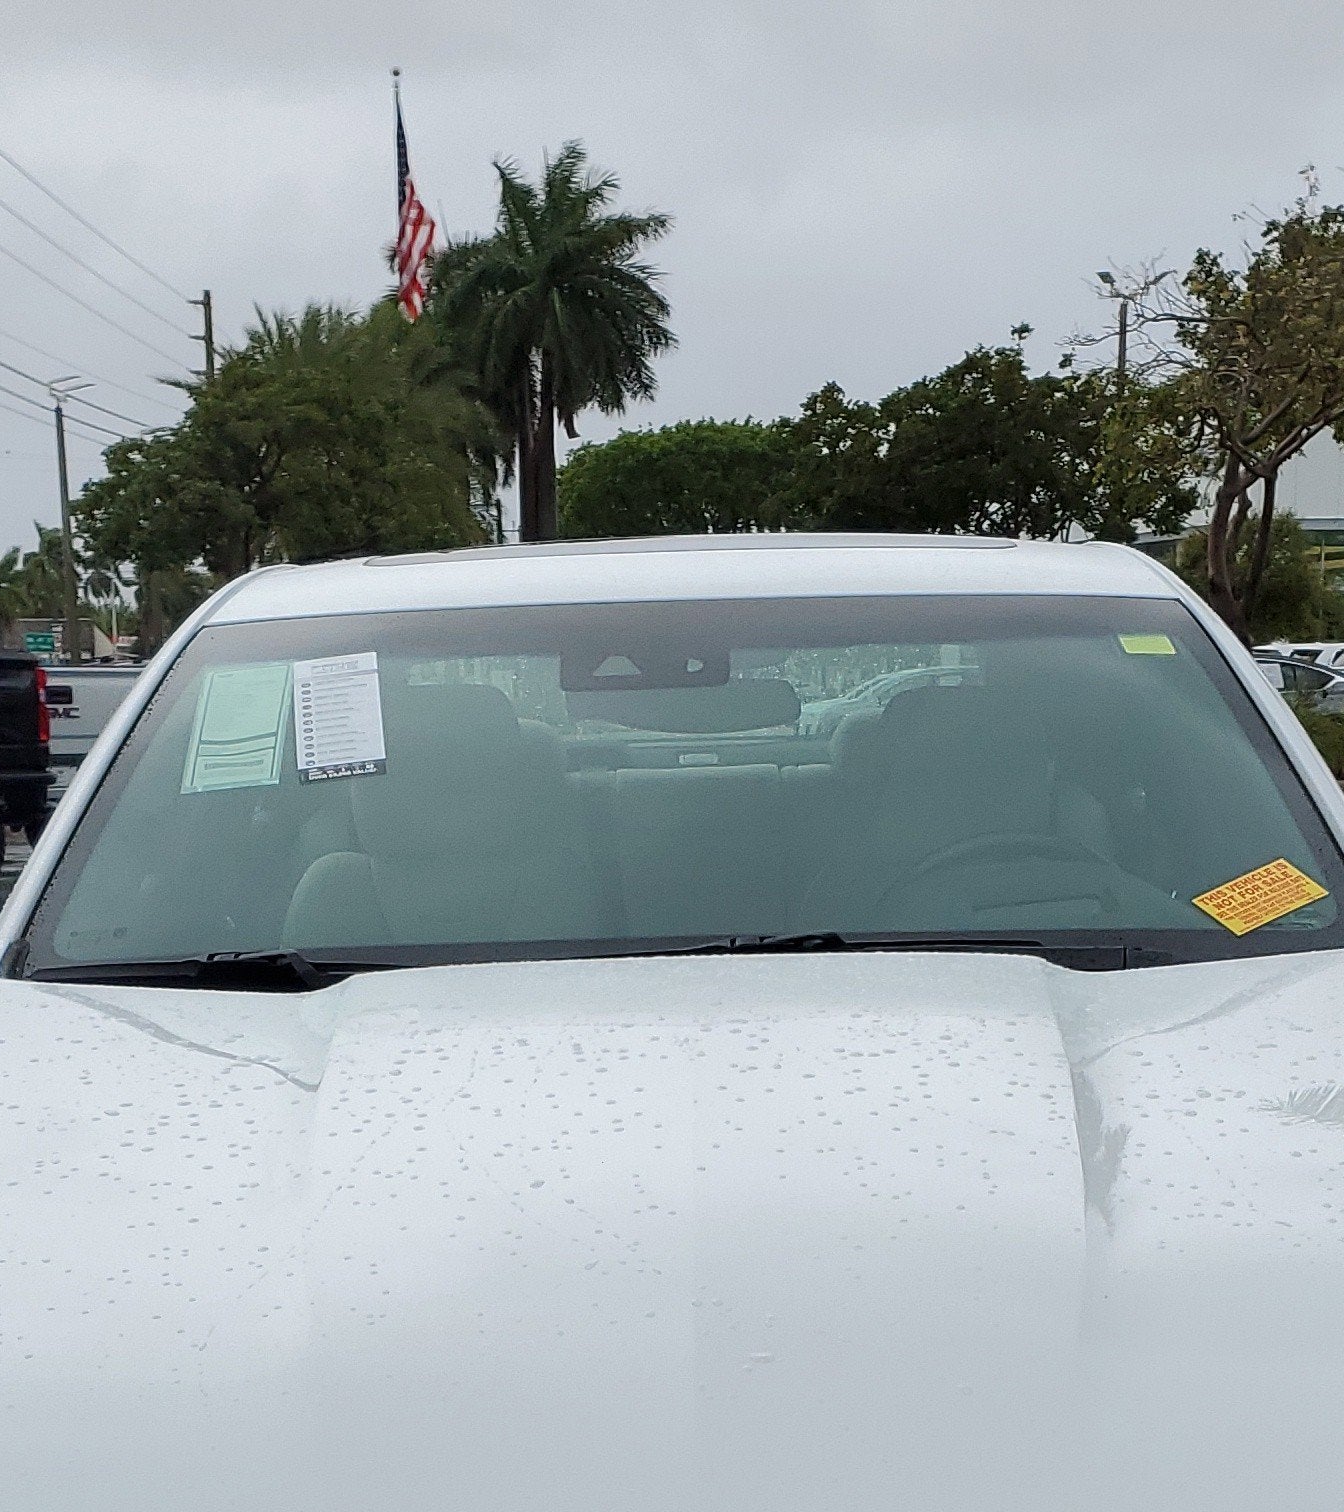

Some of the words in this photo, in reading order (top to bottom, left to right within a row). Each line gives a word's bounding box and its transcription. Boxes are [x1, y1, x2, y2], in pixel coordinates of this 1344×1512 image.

[1199, 889, 1226, 906] THIS
[1226, 868, 1273, 893] VEHICLE
[1273, 862, 1288, 873] IS
[1213, 894, 1235, 910] NOT
[1239, 884, 1264, 900] FOR
[1266, 871, 1293, 888] SALE
